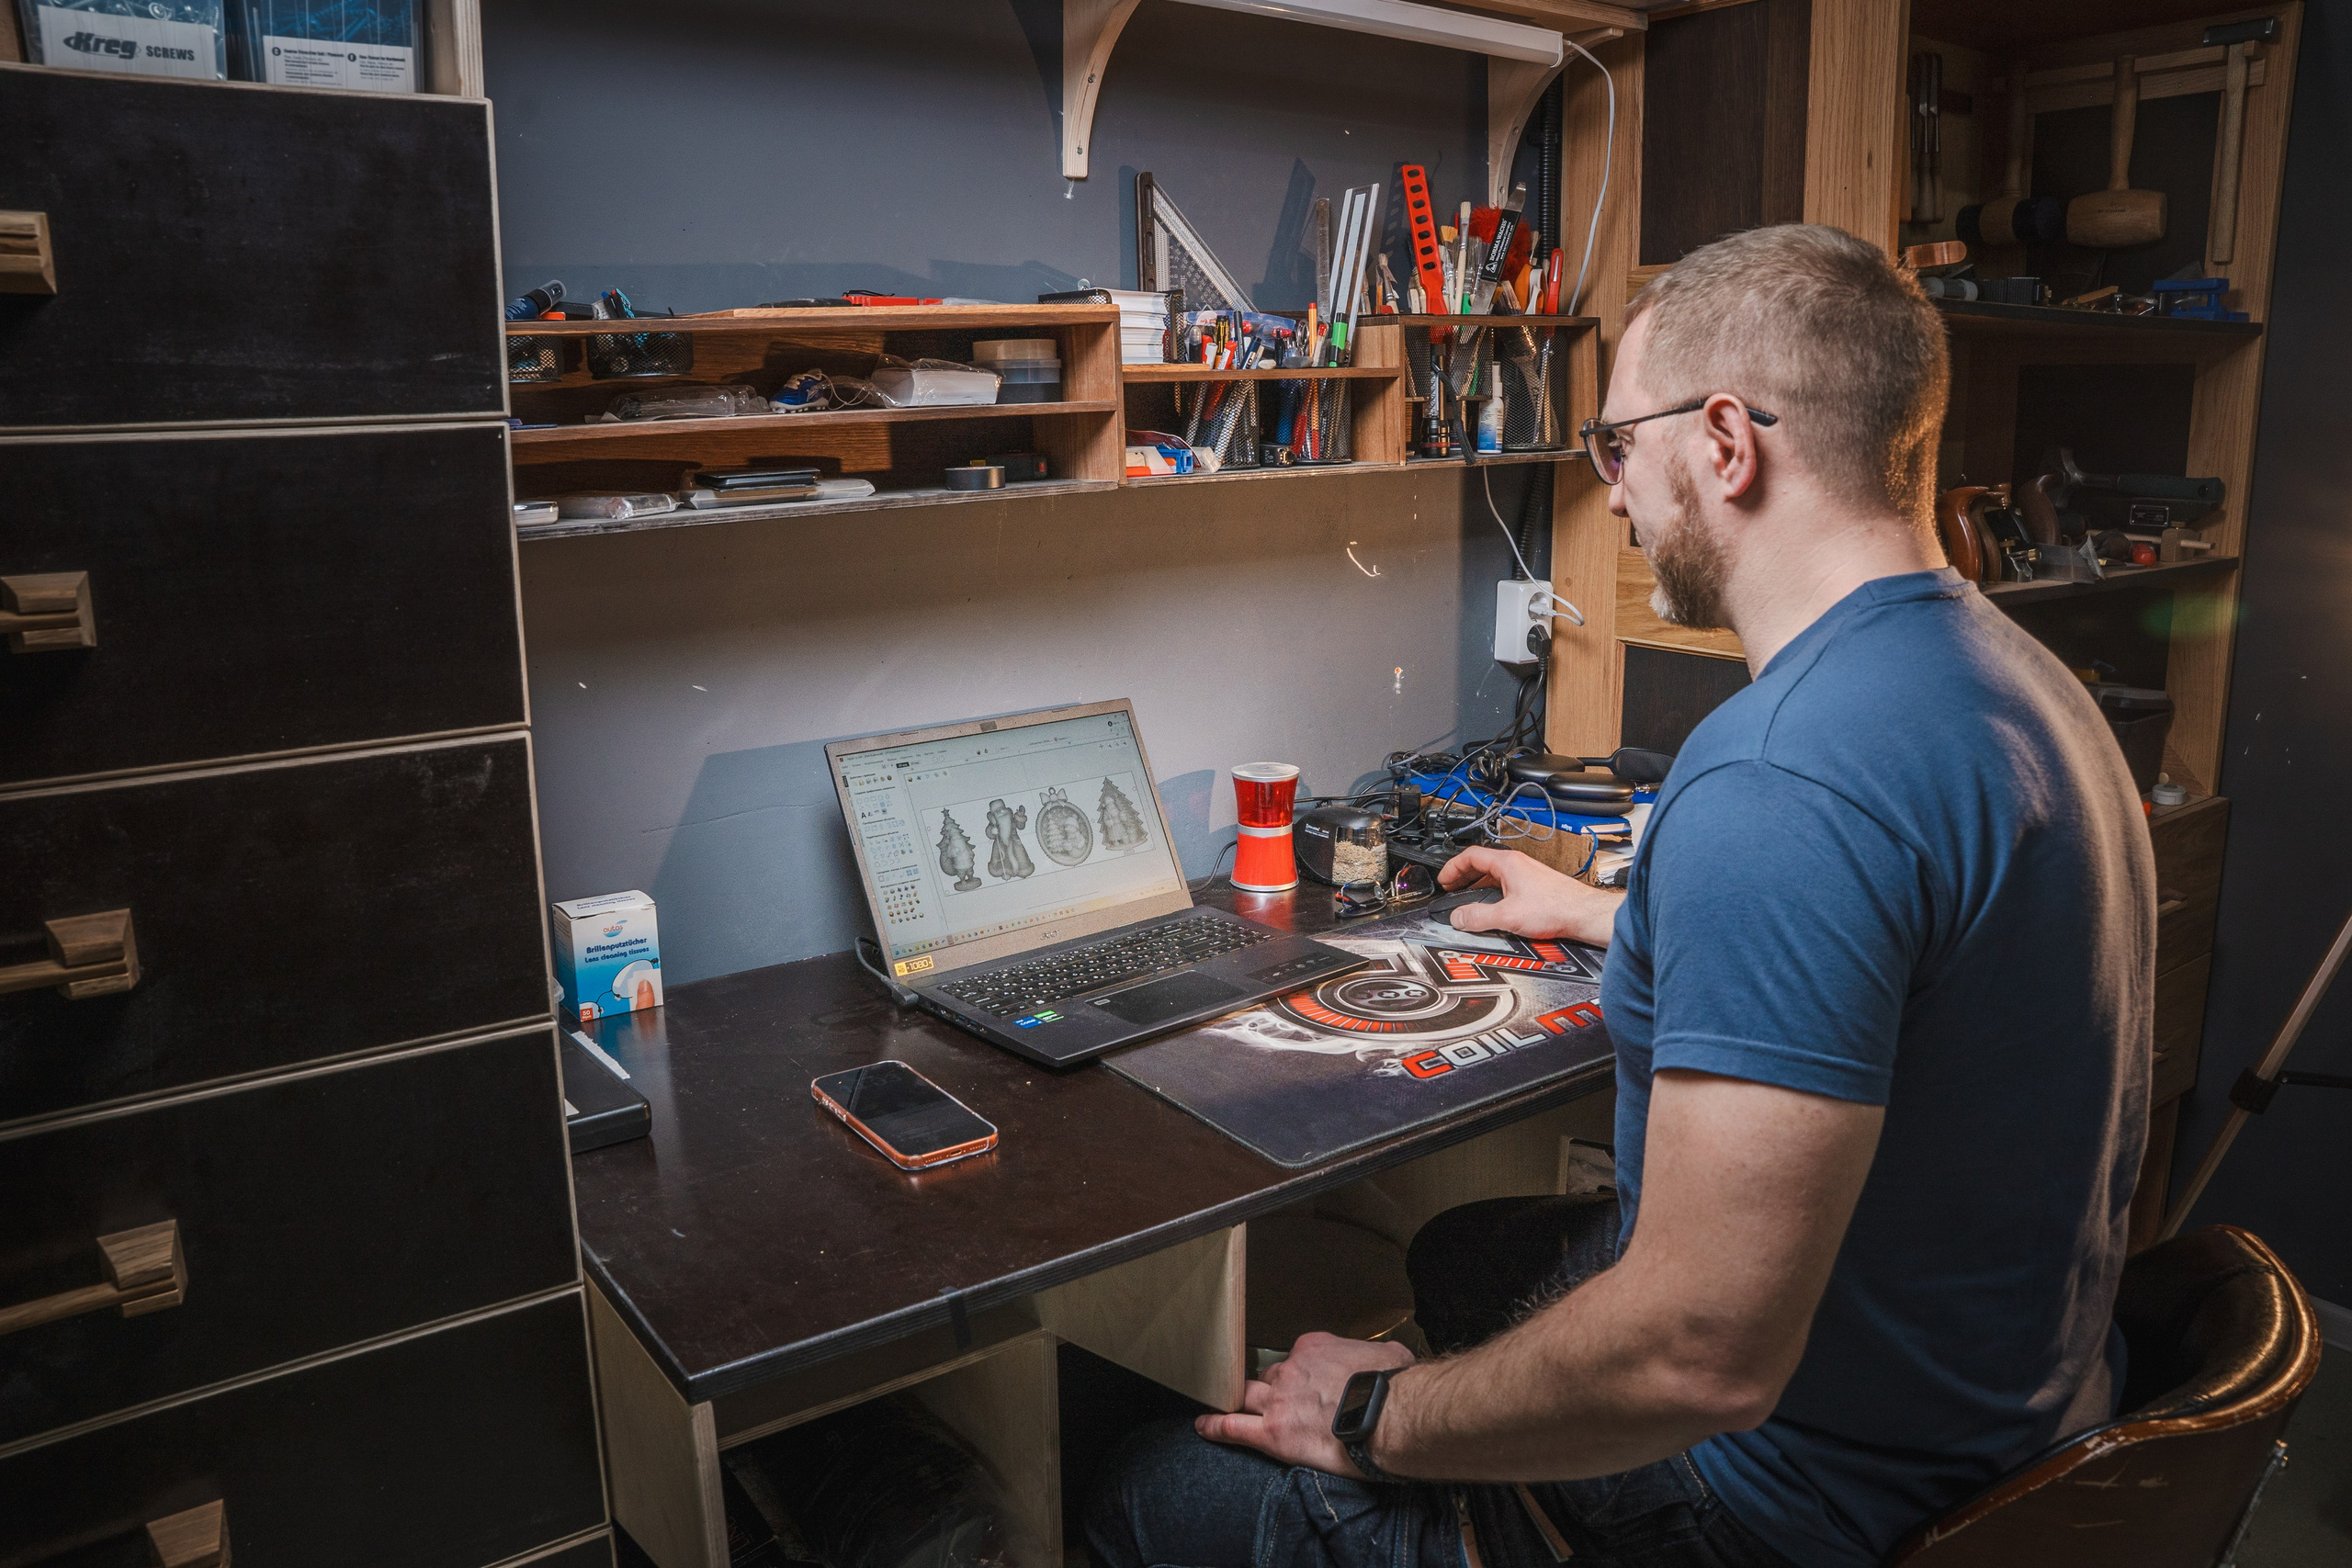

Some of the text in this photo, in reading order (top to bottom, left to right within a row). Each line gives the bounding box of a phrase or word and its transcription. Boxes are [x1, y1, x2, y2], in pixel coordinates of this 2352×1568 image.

[74, 31, 195, 62] Kreg SCREWS
[586, 938, 647, 953] Brillenputztücher
[584, 946, 650, 964] Lens cleaning tissues
[910, 959, 929, 971] 1080
